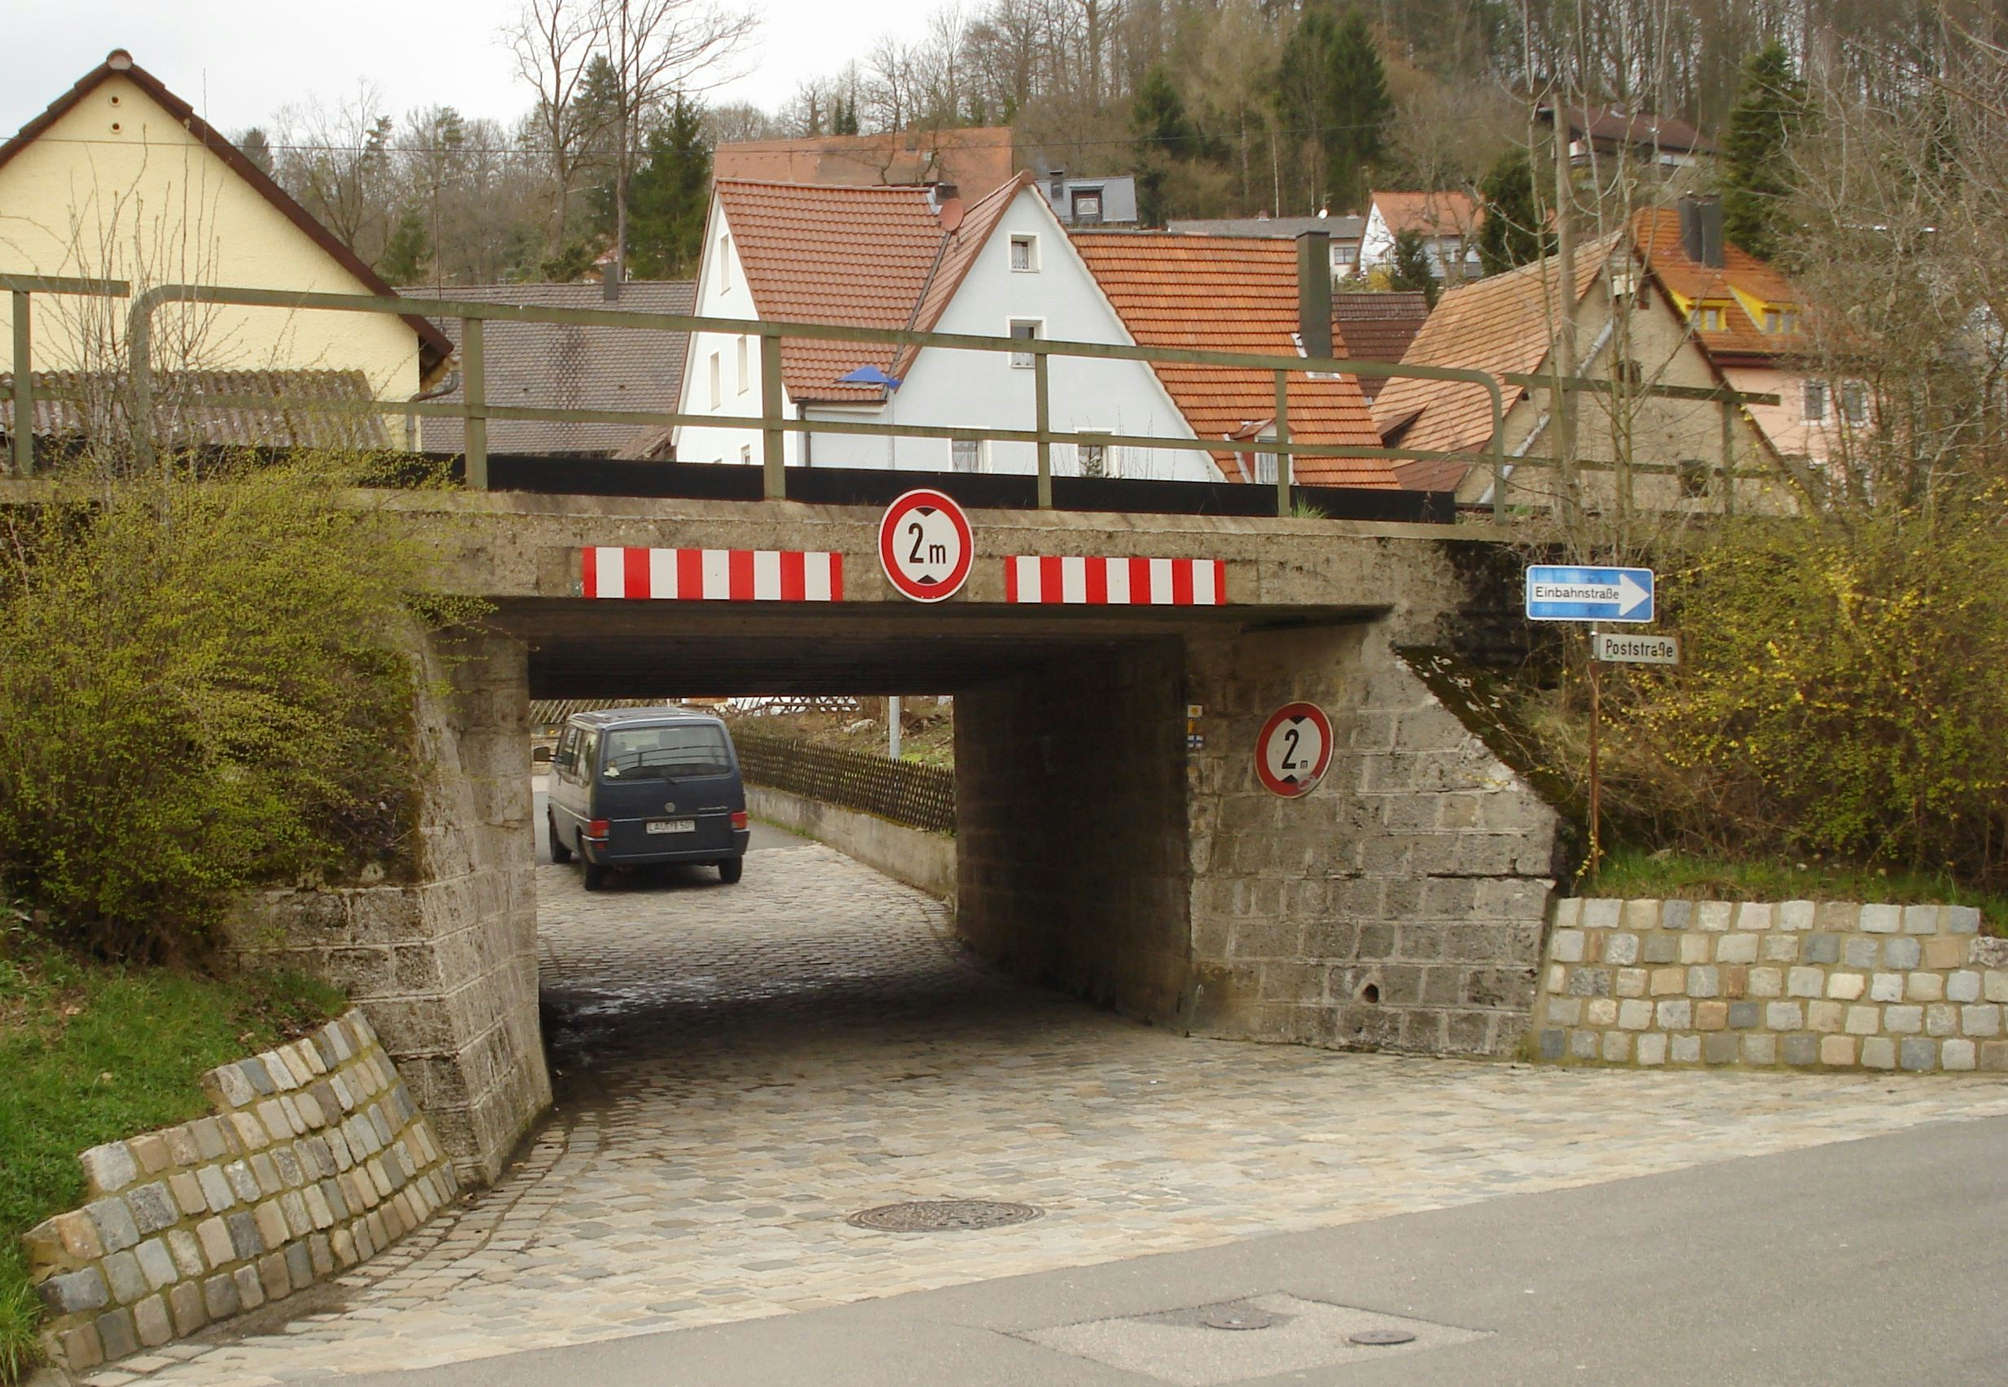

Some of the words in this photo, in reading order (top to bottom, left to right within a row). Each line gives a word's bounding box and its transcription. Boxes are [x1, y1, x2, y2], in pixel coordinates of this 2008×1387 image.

[908, 522, 924, 564] 2
[929, 544, 946, 564] m
[1535, 586, 1620, 600] Einbahnstraße
[1605, 638, 1674, 658] Poststraße
[1281, 728, 1300, 770] 2
